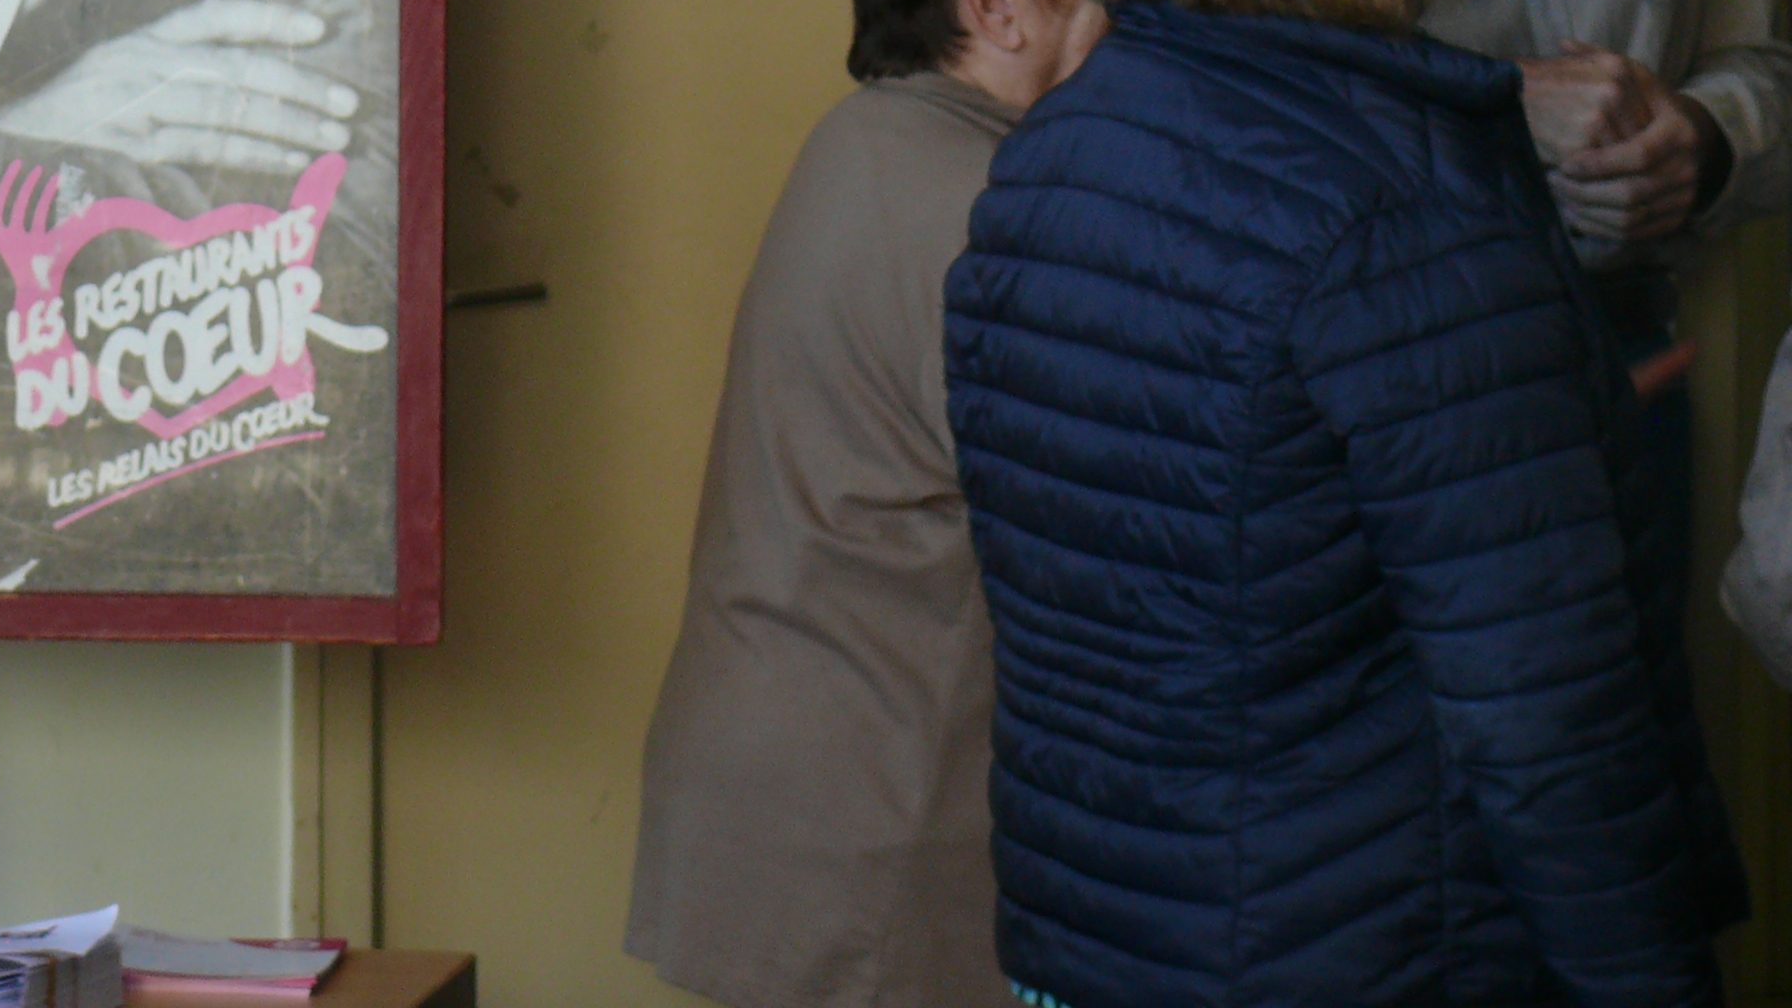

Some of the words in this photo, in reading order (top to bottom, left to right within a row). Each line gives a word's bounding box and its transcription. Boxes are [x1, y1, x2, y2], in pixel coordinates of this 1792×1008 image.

[7, 297, 66, 363] LES
[75, 205, 316, 339] RESTAURANTS
[14, 352, 90, 430] DU
[47, 467, 94, 508] LES
[96, 436, 187, 494] RELAIS
[189, 421, 231, 459] DU
